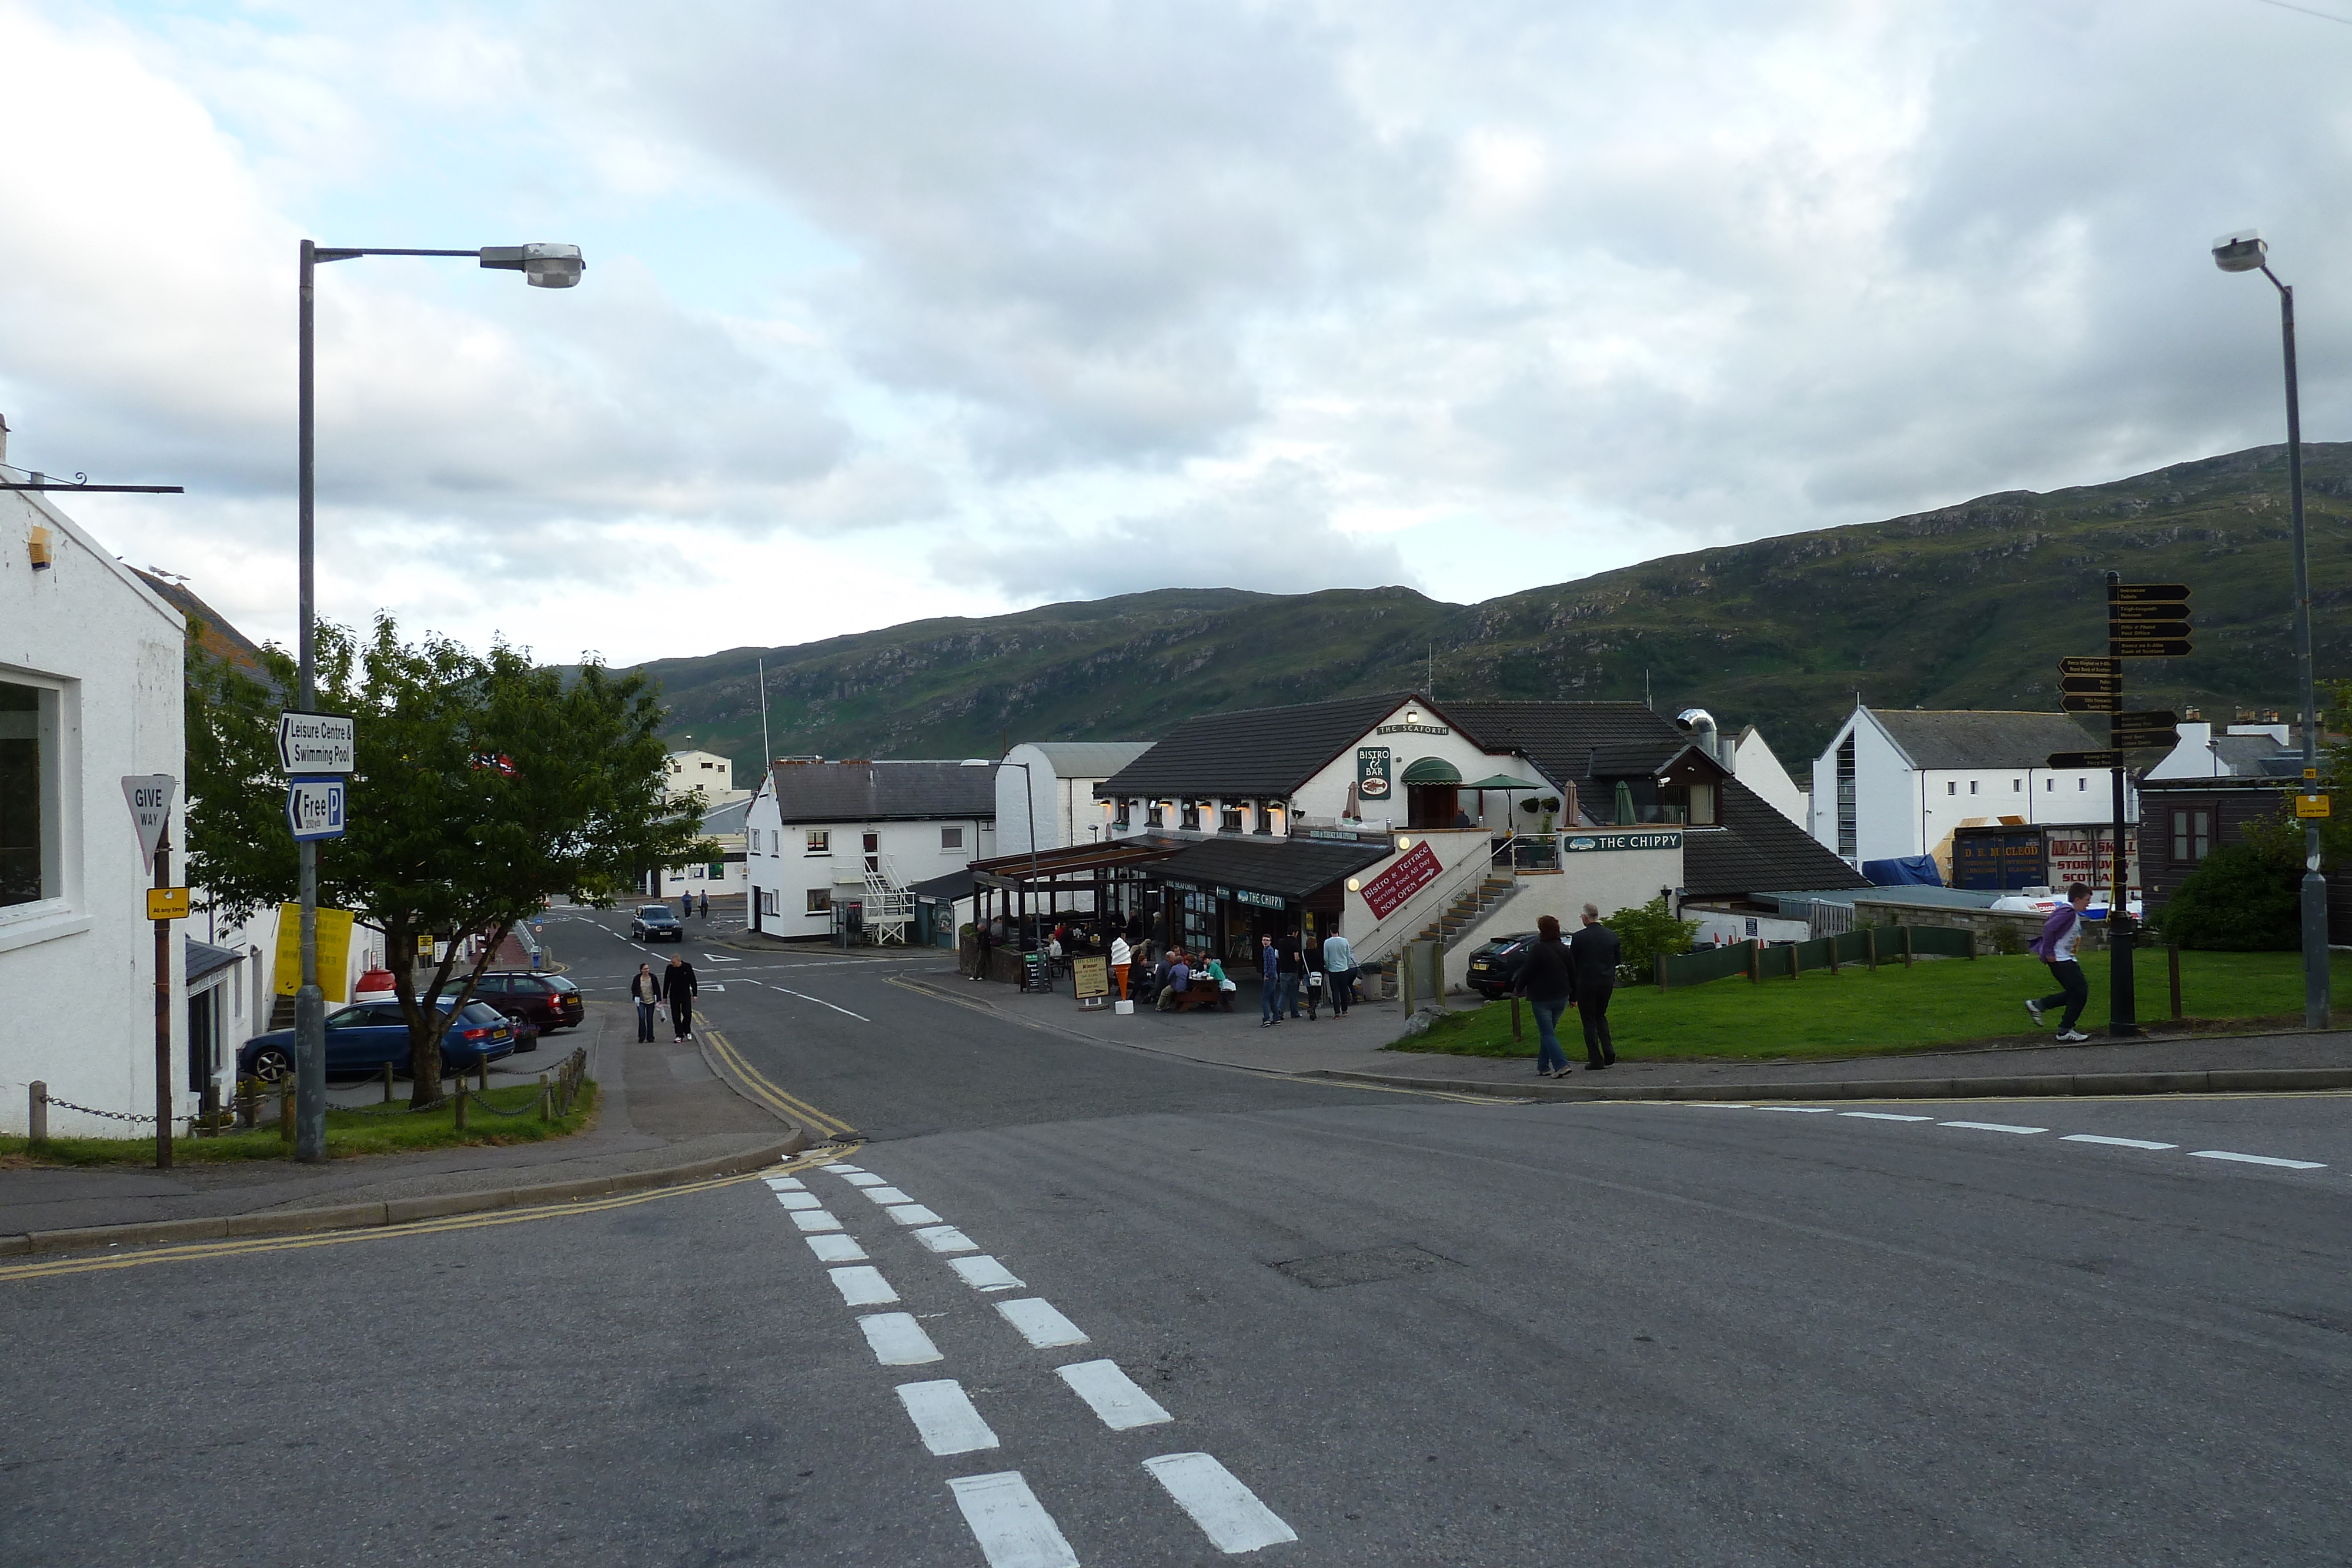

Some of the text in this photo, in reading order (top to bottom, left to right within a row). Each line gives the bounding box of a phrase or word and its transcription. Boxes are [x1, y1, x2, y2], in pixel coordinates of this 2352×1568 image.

[291, 720, 352, 740] Leisure Centre &
[1402, 725, 1446, 734] SEAFORTH
[295, 744, 349, 765] Swimming Pool
[1359, 750, 1389, 759] BISTRO
[1366, 767, 1383, 775] BAR
[1369, 757, 1380, 770] &
[135, 788, 162, 807] GIVE
[304, 794, 326, 817] Free
[141, 813, 158, 826] WAY
[1599, 835, 1677, 848] THE CHIPPY
[1364, 878, 1389, 900] Bistro
[1397, 846, 1429, 872] Terrace
[1374, 858, 1431, 904] Serving Food All Day
[1249, 892, 1282, 908] THE CHIPPY
[1380, 881, 1418, 912] NOW OPEN
[1451, 888, 1468, 905] BISTRO
